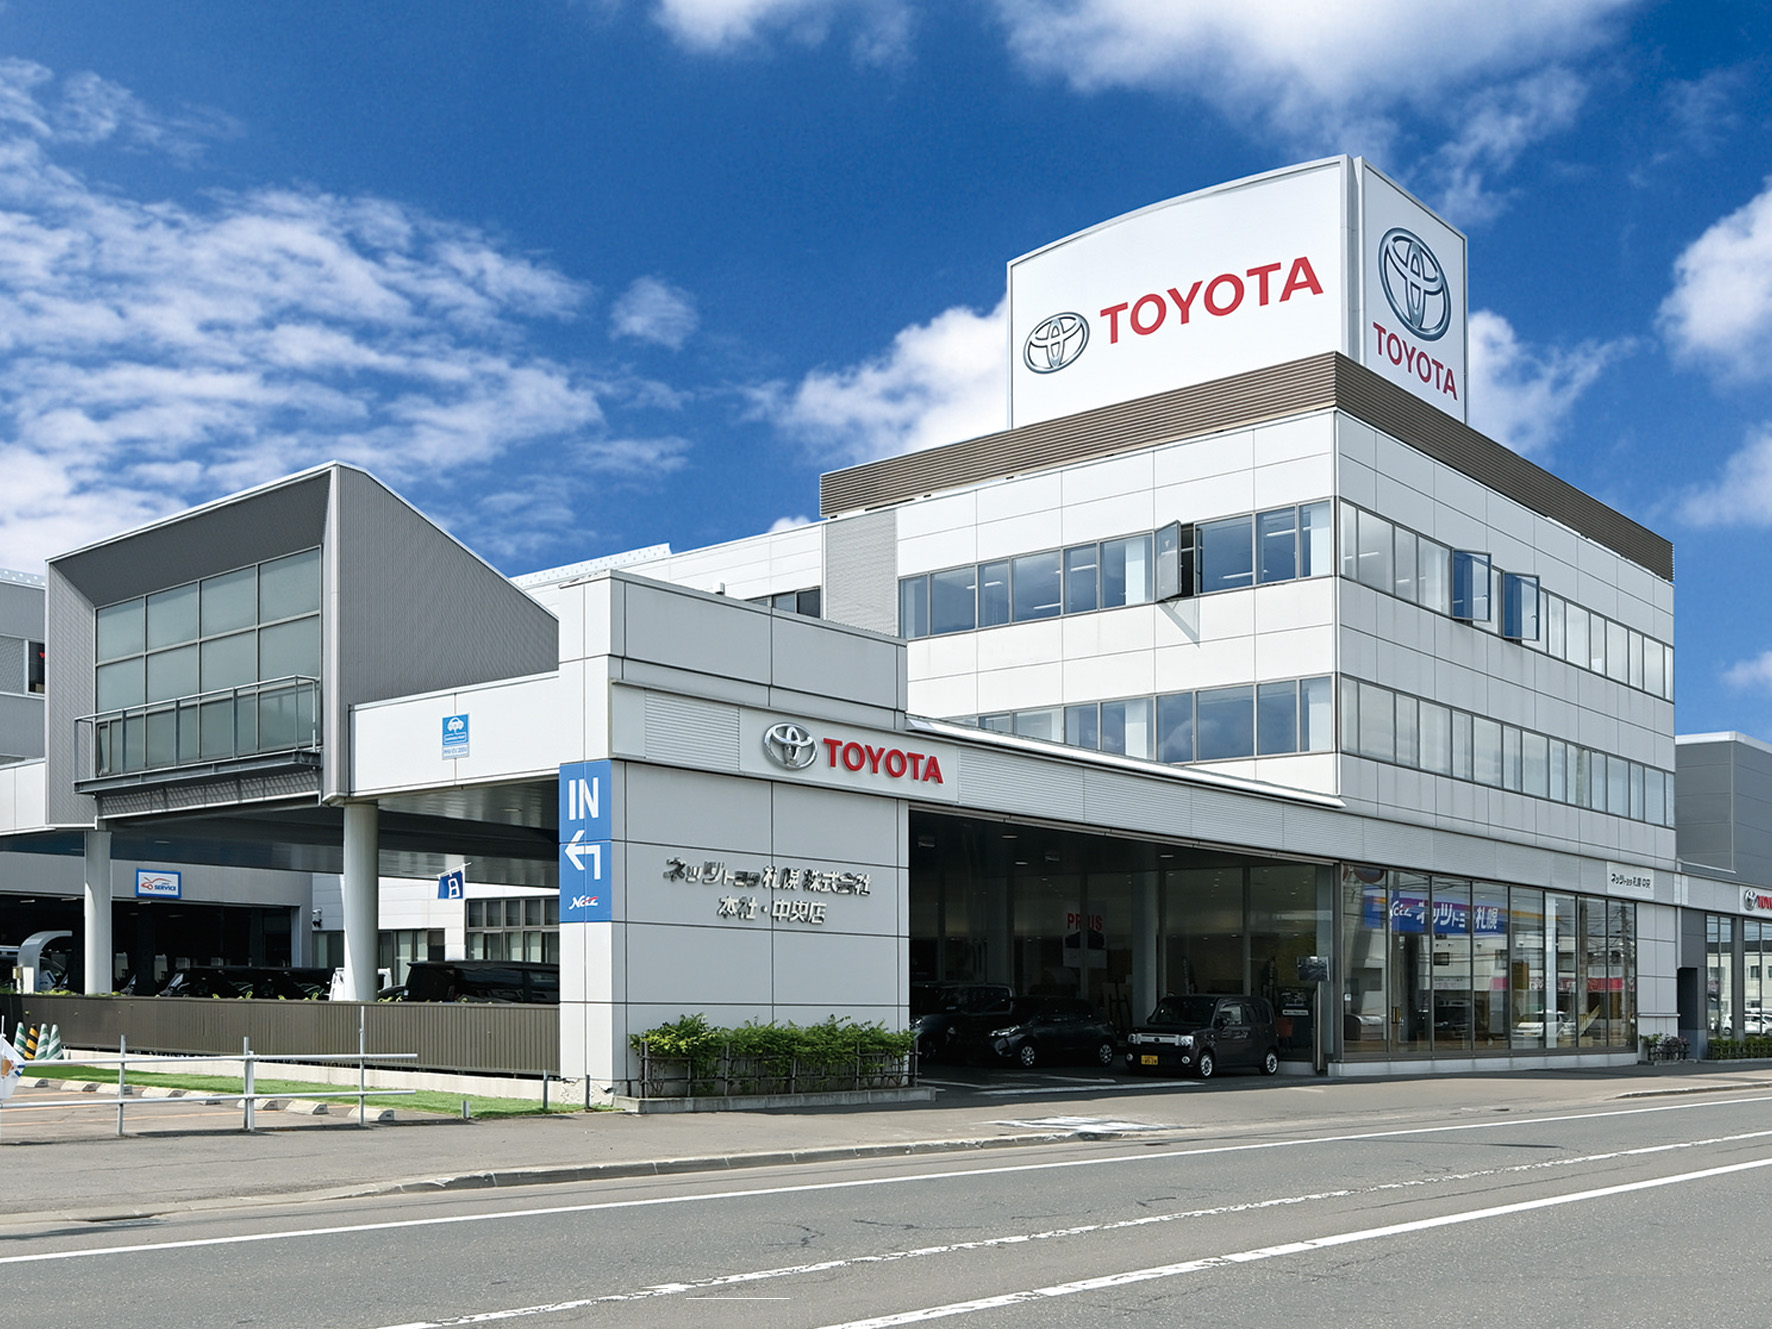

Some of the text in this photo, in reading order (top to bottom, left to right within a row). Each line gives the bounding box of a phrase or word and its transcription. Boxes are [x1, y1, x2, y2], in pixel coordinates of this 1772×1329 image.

[1100, 256, 1323, 344] TOYOTA
[1373, 322, 1458, 400] TOYOTA
[823, 737, 944, 784] TOYOTA
[568, 778, 599, 820] IN
[569, 895, 599, 910] Netz
[1067, 912, 1103, 931] PRUS
